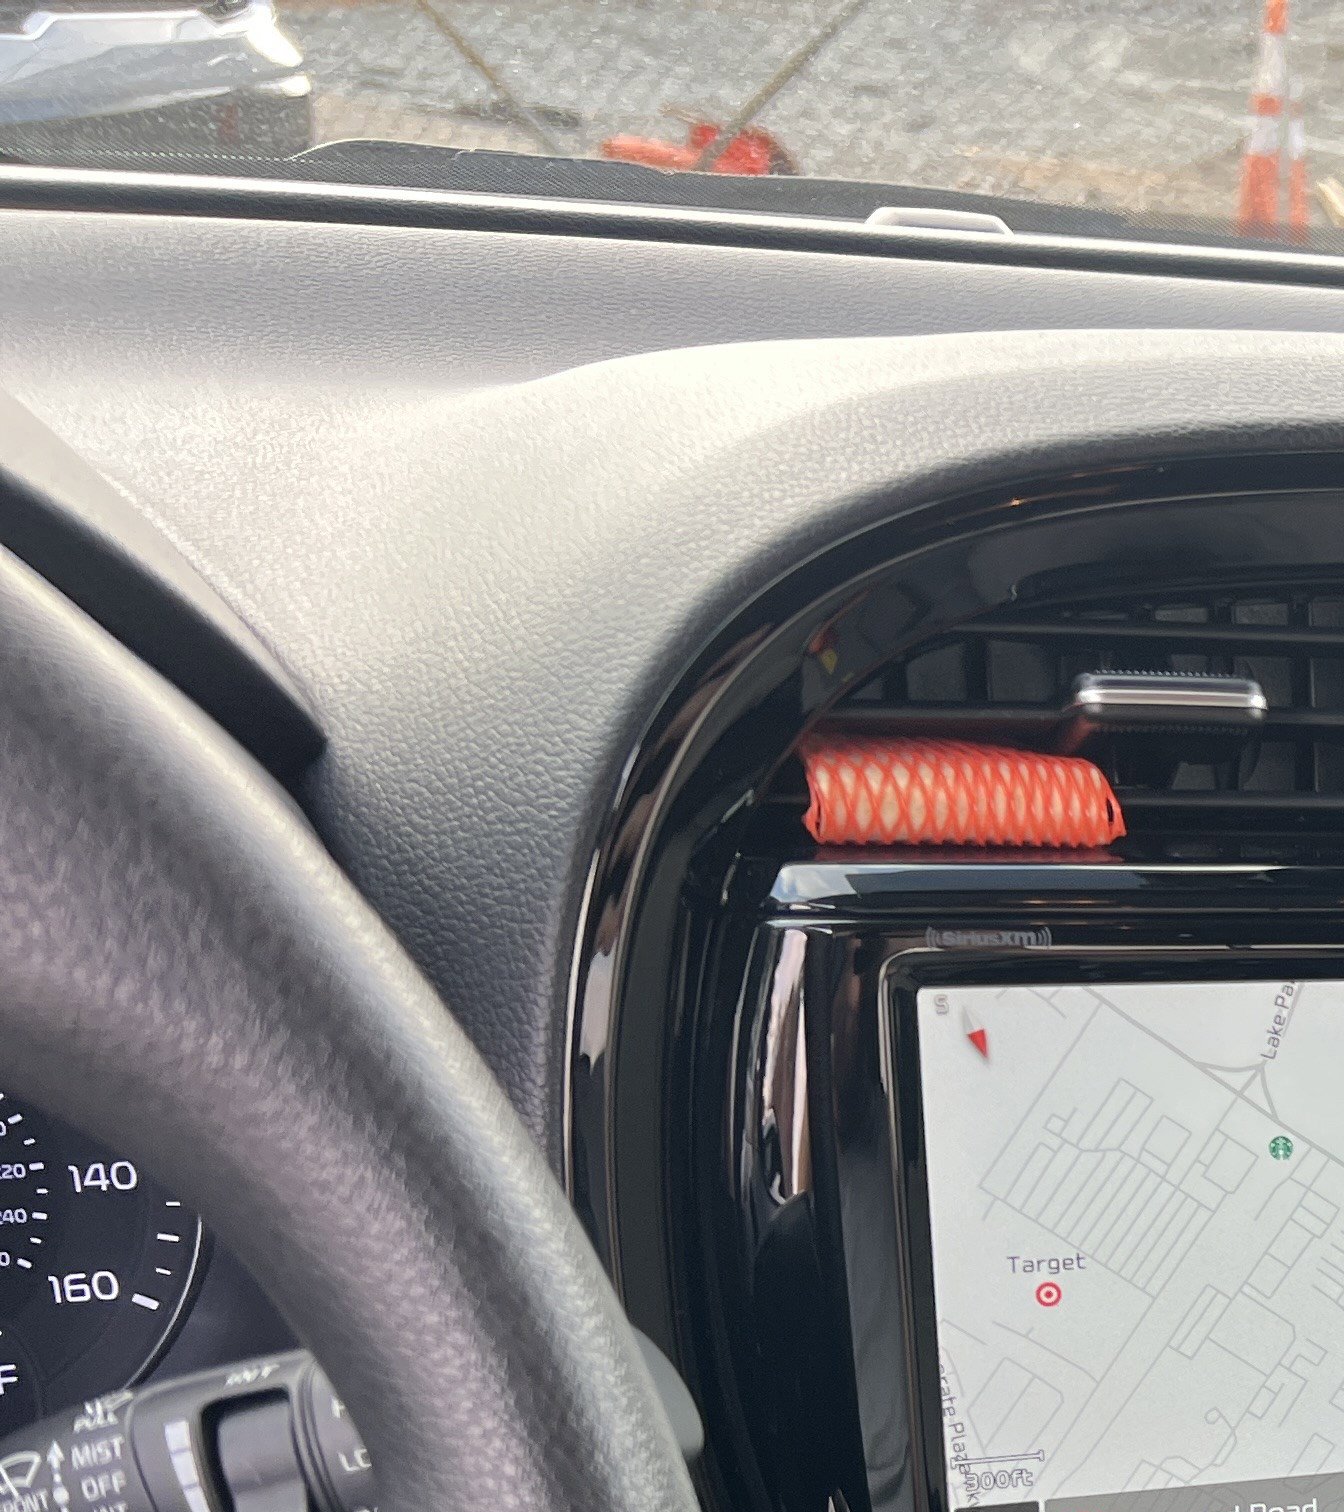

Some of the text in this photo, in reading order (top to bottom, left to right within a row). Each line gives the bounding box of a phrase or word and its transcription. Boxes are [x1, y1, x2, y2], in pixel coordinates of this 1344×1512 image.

[1260, 1014, 1286, 1060] Lake
[0, 1163, 26, 1180] 20
[67, 1160, 138, 1194] 140
[0, 1207, 28, 1226] 40
[1007, 1252, 1087, 1276] Target
[47, 1270, 120, 1304] 160
[80, 1469, 127, 1502] OFF
